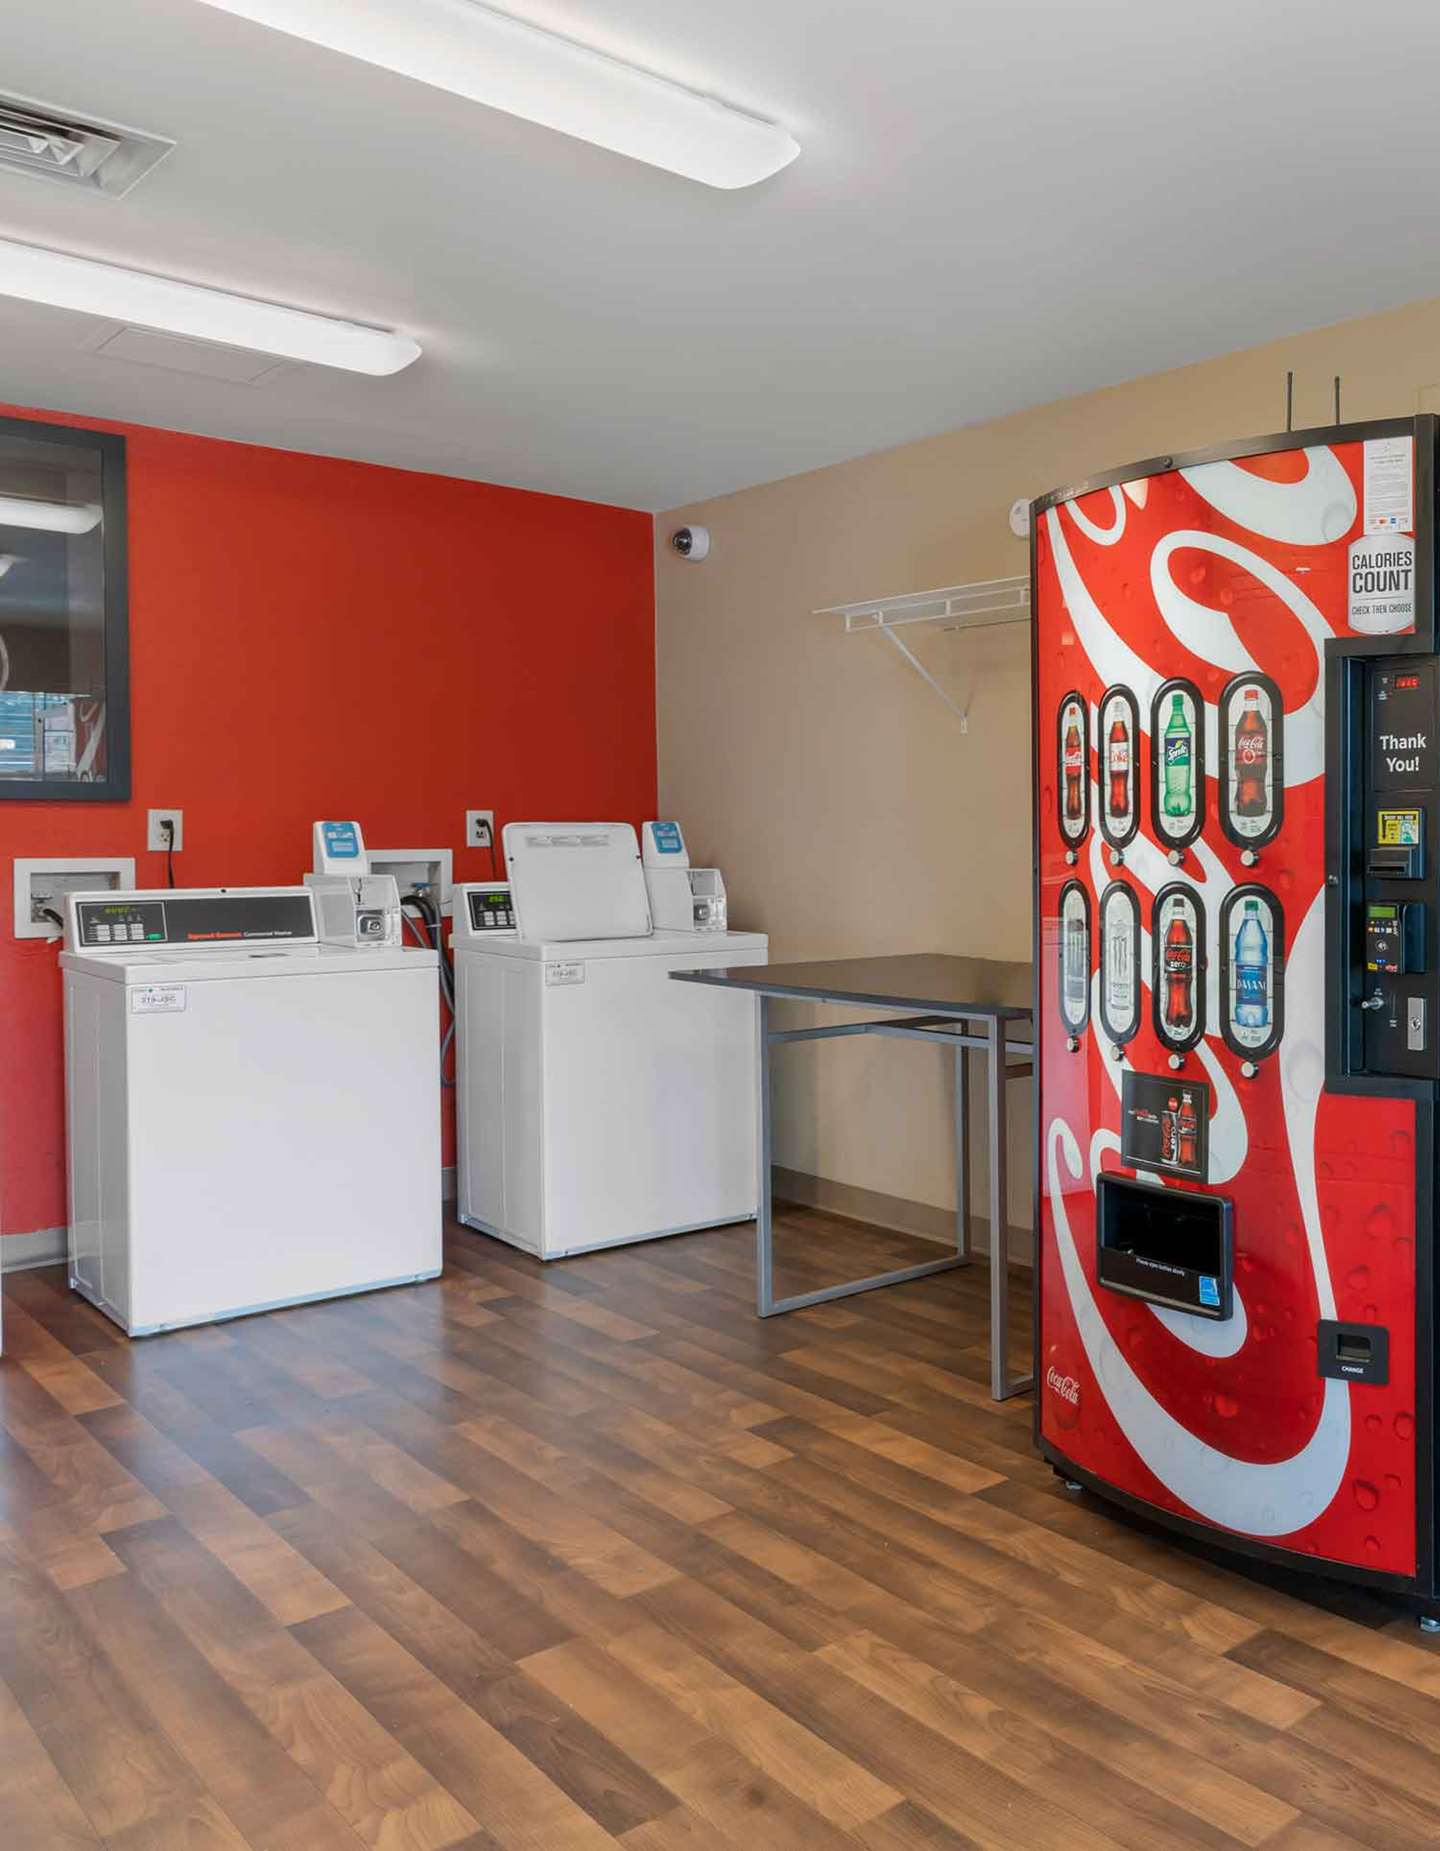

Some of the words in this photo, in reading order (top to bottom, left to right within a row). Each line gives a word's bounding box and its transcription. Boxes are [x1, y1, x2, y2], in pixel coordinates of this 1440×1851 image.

[1352, 551, 1412, 570] CALORIES
[1353, 569, 1411, 593] COUNT
[1352, 604, 1370, 615] CHECK
[1372, 603, 1387, 614] THEN
[1389, 602, 1412, 614] CHOOSE
[1380, 732, 1427, 750] Thank
[1167, 743, 1189, 760] Sprite
[1386, 756, 1419, 772] You!
